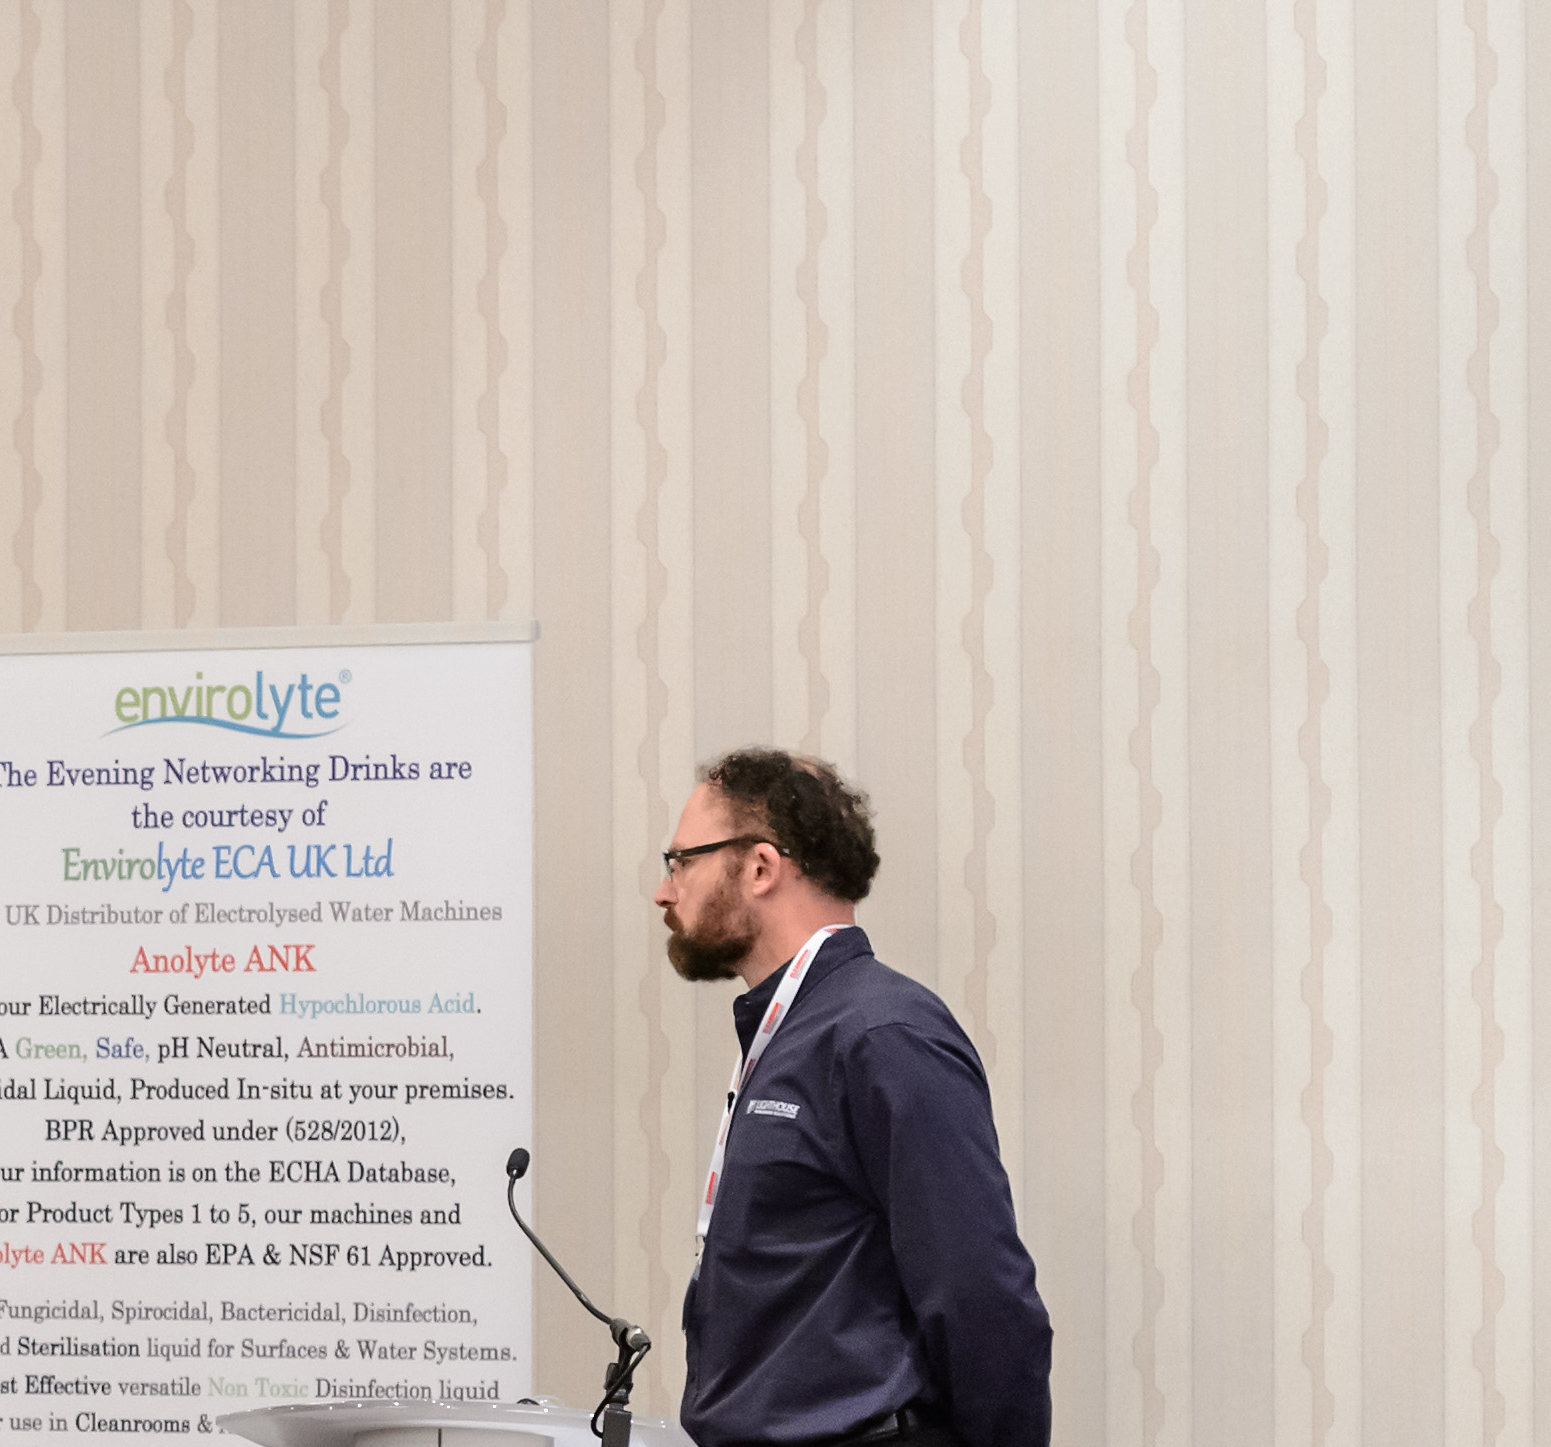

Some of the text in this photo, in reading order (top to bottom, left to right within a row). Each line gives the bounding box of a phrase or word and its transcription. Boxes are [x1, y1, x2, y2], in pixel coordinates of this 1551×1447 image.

[47, 760, 155, 791] Evening
[164, 756, 320, 788] Networking
[329, 754, 419, 781] Drinks
[430, 762, 472, 780] are
[131, 800, 328, 832] the courtesy of
[61, 838, 395, 892] Envirolyte ECA UK Ltd
[5, 905, 40, 926] UK
[47, 904, 163, 925] Distributor
[169, 903, 189, 924] of
[195, 902, 322, 928] Electrolysed
[329, 901, 394, 922] Water
[400, 900, 502, 921] Machines
[130, 944, 316, 979] Anolyte ANK
[39, 995, 157, 1019] Electrically
[164, 994, 271, 1015] Generated
[280, 993, 421, 1019] Hypochlorous
[427, 992, 481, 1014] Acid.
[16, 1037, 87, 1063] Green,
[96, 1037, 149, 1063] Safe,
[158, 1037, 189, 1063] pH
[197, 1037, 288, 1062] Neutral,
[297, 1036, 454, 1061] Antimicrobial,
[43, 1078, 121, 1105] Liquid,
[130, 1078, 229, 1100] Produced
[237, 1078, 313, 1099] In-situ
[321, 1080, 342, 1099] at
[349, 1085, 398, 1104] your
[405, 1078, 514, 1104] premises.
[46, 1117, 405, 1146] BPR Approved under (528/2012),
[32, 1160, 161, 1182] information
[168, 1160, 185, 1182] is
[192, 1168, 217, 1182] on
[225, 1161, 260, 1182] the
[269, 1161, 340, 1183] ECHA
[348, 1161, 455, 1187] Database,
[27, 1201, 113, 1223] Product
[120, 1202, 183, 1228] Types
[192, 1203, 201, 1223] 1
[210, 1204, 230, 1224] to
[238, 1203, 256, 1227] 5,
[265, 1209, 302, 1224] our
[310, 1203, 412, 1224] machines
[420, 1203, 461, 1224] and
[51, 1243, 107, 1264] ANK
[115, 1250, 149, 1264] are
[157, 1243, 197, 1265] also
[206, 1243, 255, 1265] EPA
[263, 1244, 281, 1265] &
[290, 1244, 340, 1266] NSF
[347, 1246, 370, 1266] 61
[378, 1244, 492, 1271] Approved.
[112, 1300, 213, 1324] Spirocidal,
[221, 1301, 345, 1325] Bactericidal,
[354, 1302, 477, 1326] Disinfection,
[18, 1336, 140, 1357] Sterilisation
[147, 1337, 201, 1362] liquid
[208, 1338, 235, 1358] for
[241, 1339, 327, 1359] Surfaces
[335, 1339, 350, 1359] &
[357, 1340, 417, 1360] Water
[424, 1340, 516, 1365] Systems.
[25, 1375, 111, 1395] Effective
[118, 1377, 201, 1396] versatile
[208, 1377, 248, 1397] Non
[255, 1377, 308, 1397] Toxic
[316, 1378, 431, 1398] Disinfection
[439, 1380, 500, 1401] liquid
[9, 1418, 42, 1431] use
[49, 1412, 68, 1431] in
[76, 1412, 190, 1433] Cleanrooms
[197, 1414, 213, 1434] &
